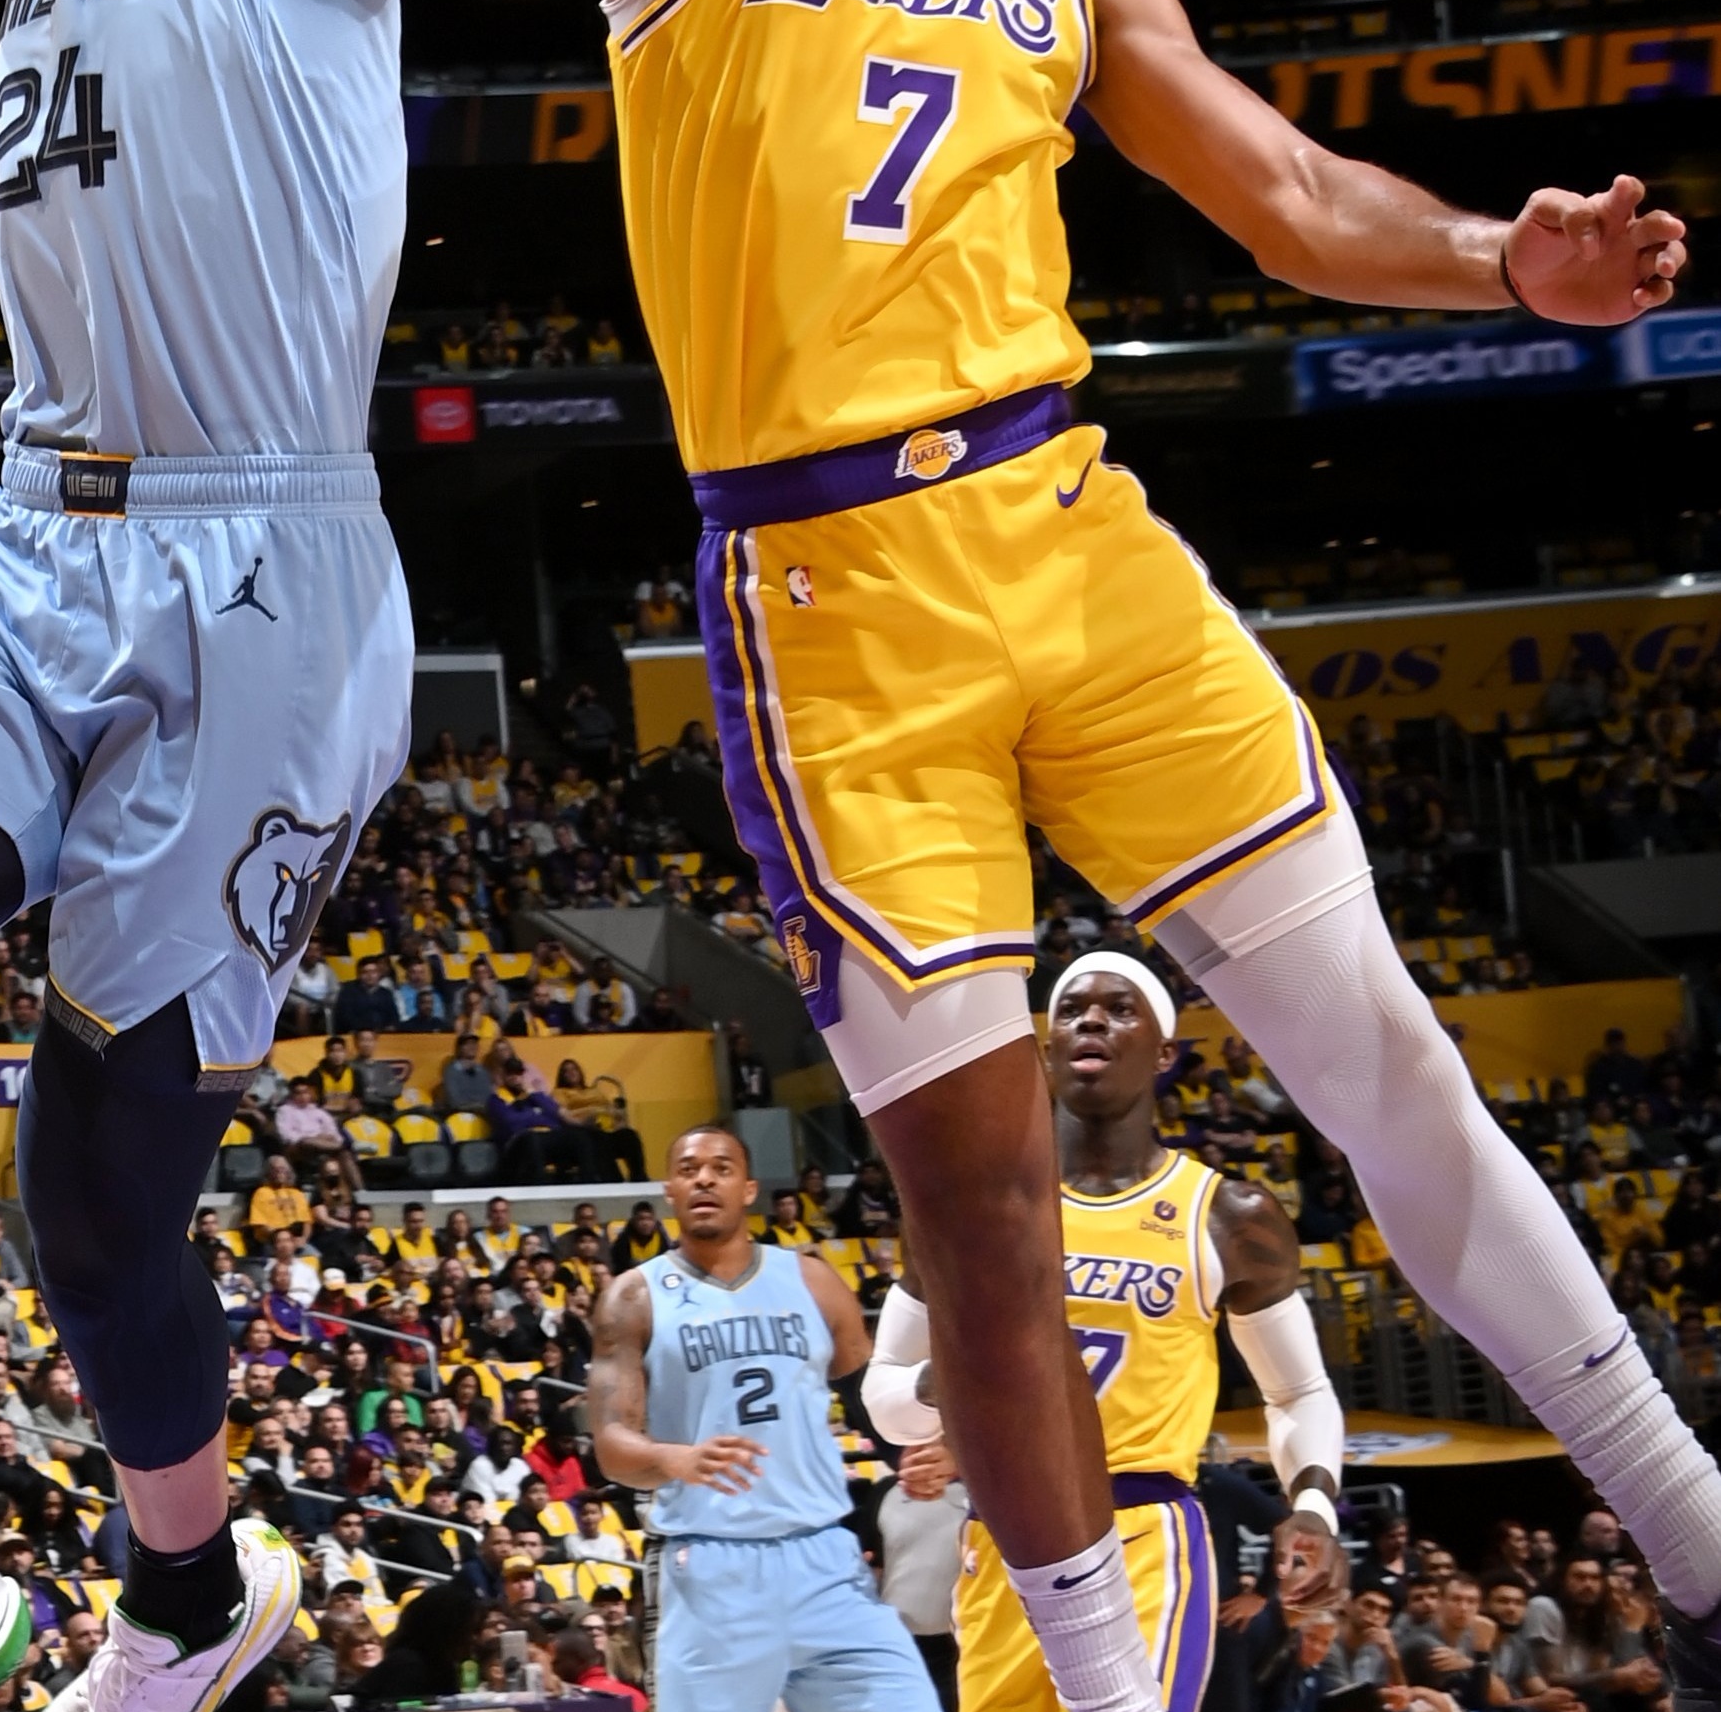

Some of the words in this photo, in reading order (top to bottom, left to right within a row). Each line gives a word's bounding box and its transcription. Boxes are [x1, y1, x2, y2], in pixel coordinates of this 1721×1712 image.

[844, 55, 961, 244] 7
[1330, 339, 1580, 399] Spectrum
[481, 397, 623, 429] TOYOTA
[900, 438, 961, 475] LAKERS
[1309, 643, 1446, 706] OS
[1139, 1218, 1186, 1241] bibigo
[679, 1312, 810, 1373] GRIZZLIES
[732, 1366, 781, 1426] 2
